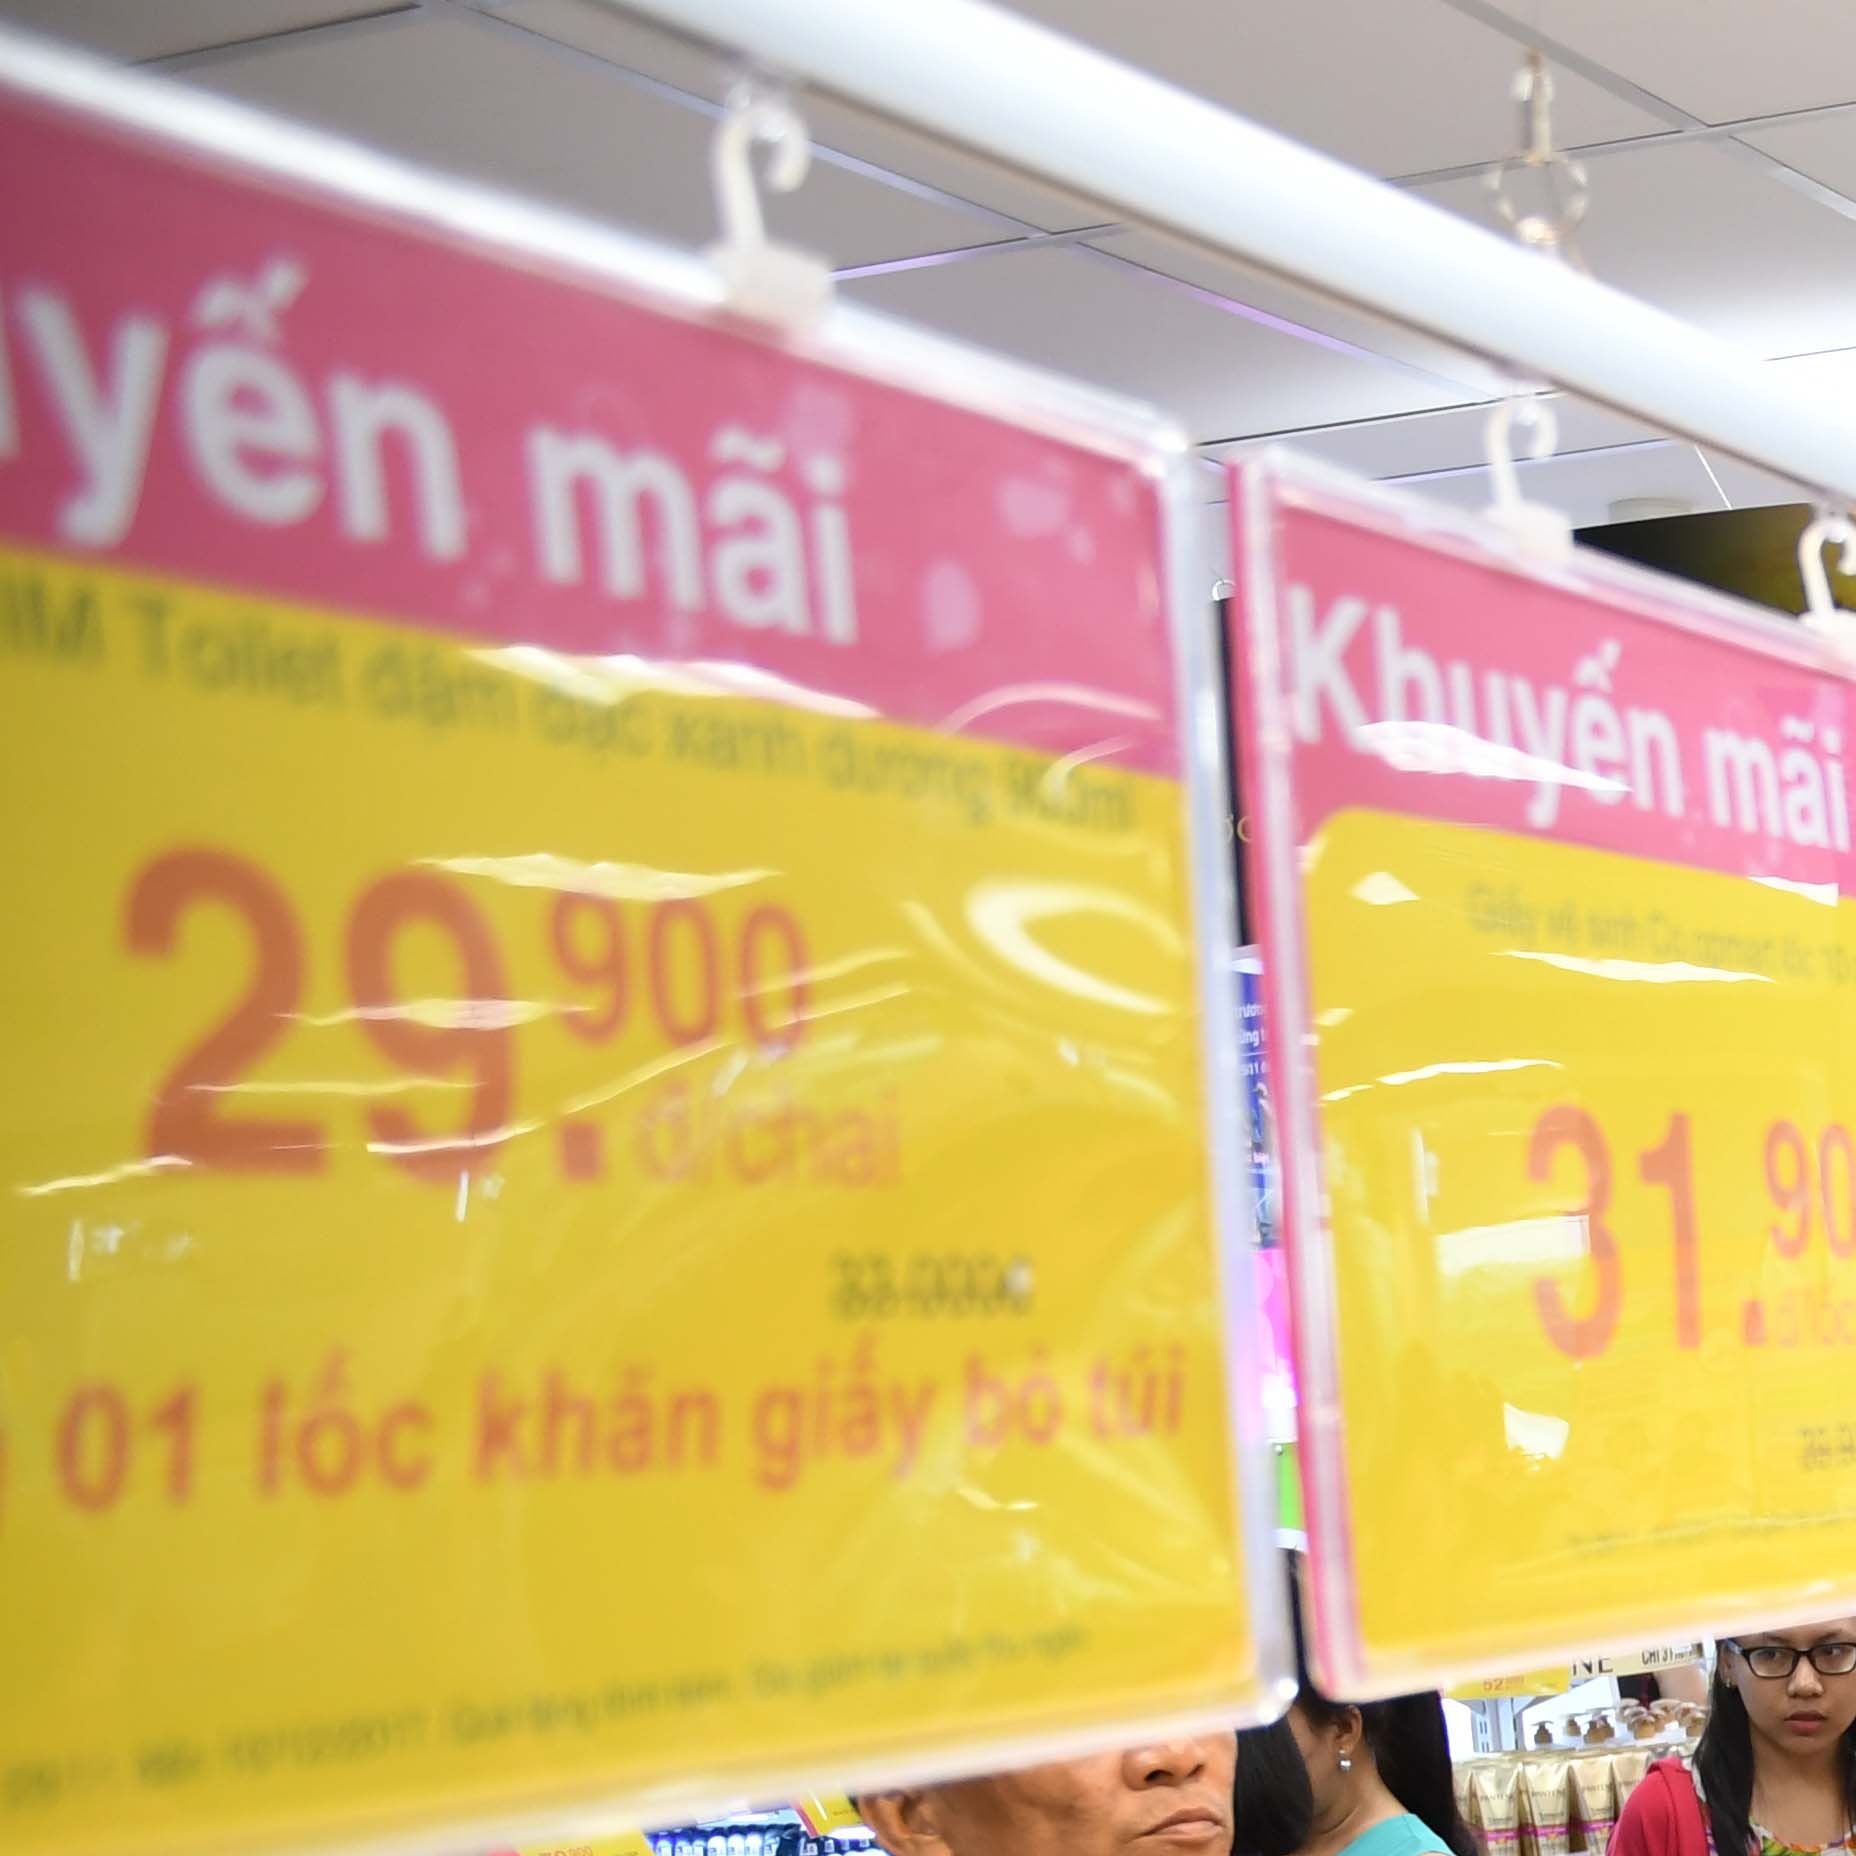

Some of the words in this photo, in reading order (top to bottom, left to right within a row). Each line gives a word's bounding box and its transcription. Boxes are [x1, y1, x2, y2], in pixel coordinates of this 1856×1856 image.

[0, 252, 470, 560] yến
[525, 421, 860, 645] mãi
[1283, 580, 1686, 828] Khuyến
[1702, 705, 1852, 853] mãi
[54, 1380, 200, 1515] 01
[252, 1342, 434, 1501] lốc
[470, 1350, 723, 1484] khăn
[750, 1317, 941, 1496] giấy
